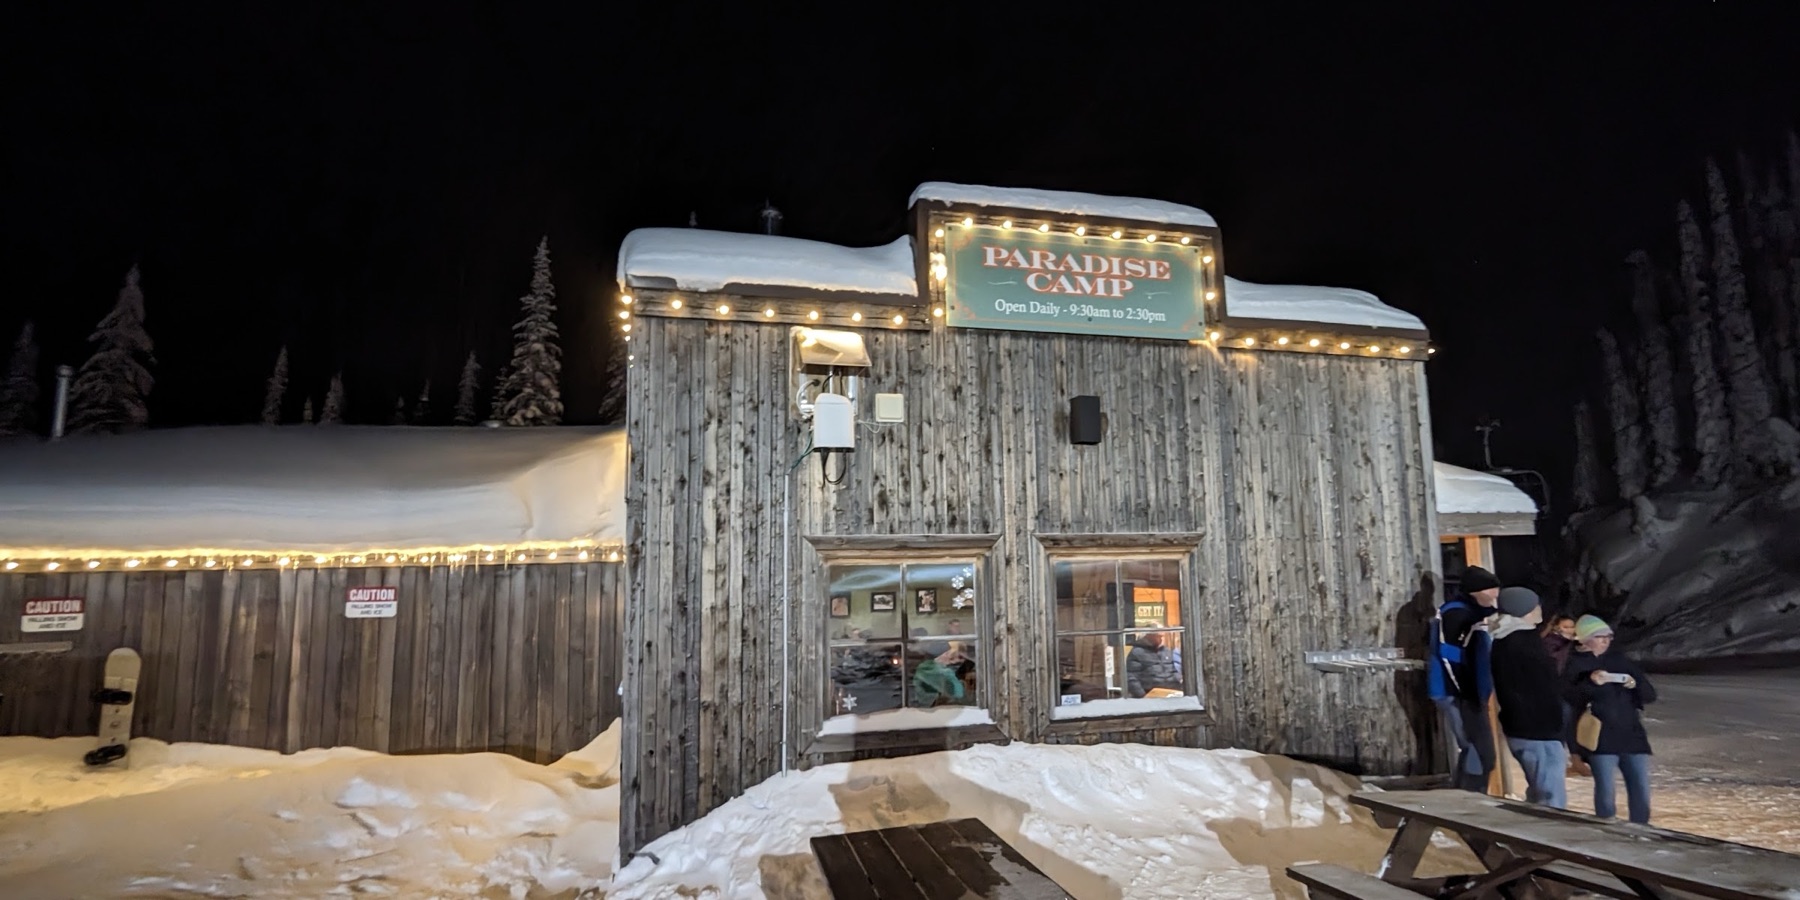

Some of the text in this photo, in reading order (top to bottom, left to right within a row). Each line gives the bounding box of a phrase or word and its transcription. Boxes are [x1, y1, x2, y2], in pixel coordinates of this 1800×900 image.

[983, 246, 1172, 280] PARADISE
[1025, 272, 1134, 297] CAMP
[995, 298, 1027, 314] Open
[1029, 301, 1060, 317] Daily
[1069, 303, 1110, 318] 9:30am
[1112, 308, 1124, 319] to
[1125, 307, 1166, 323] 2:30pm
[25, 600, 82, 614] CAUTION
[350, 588, 395, 601] CAUTION
